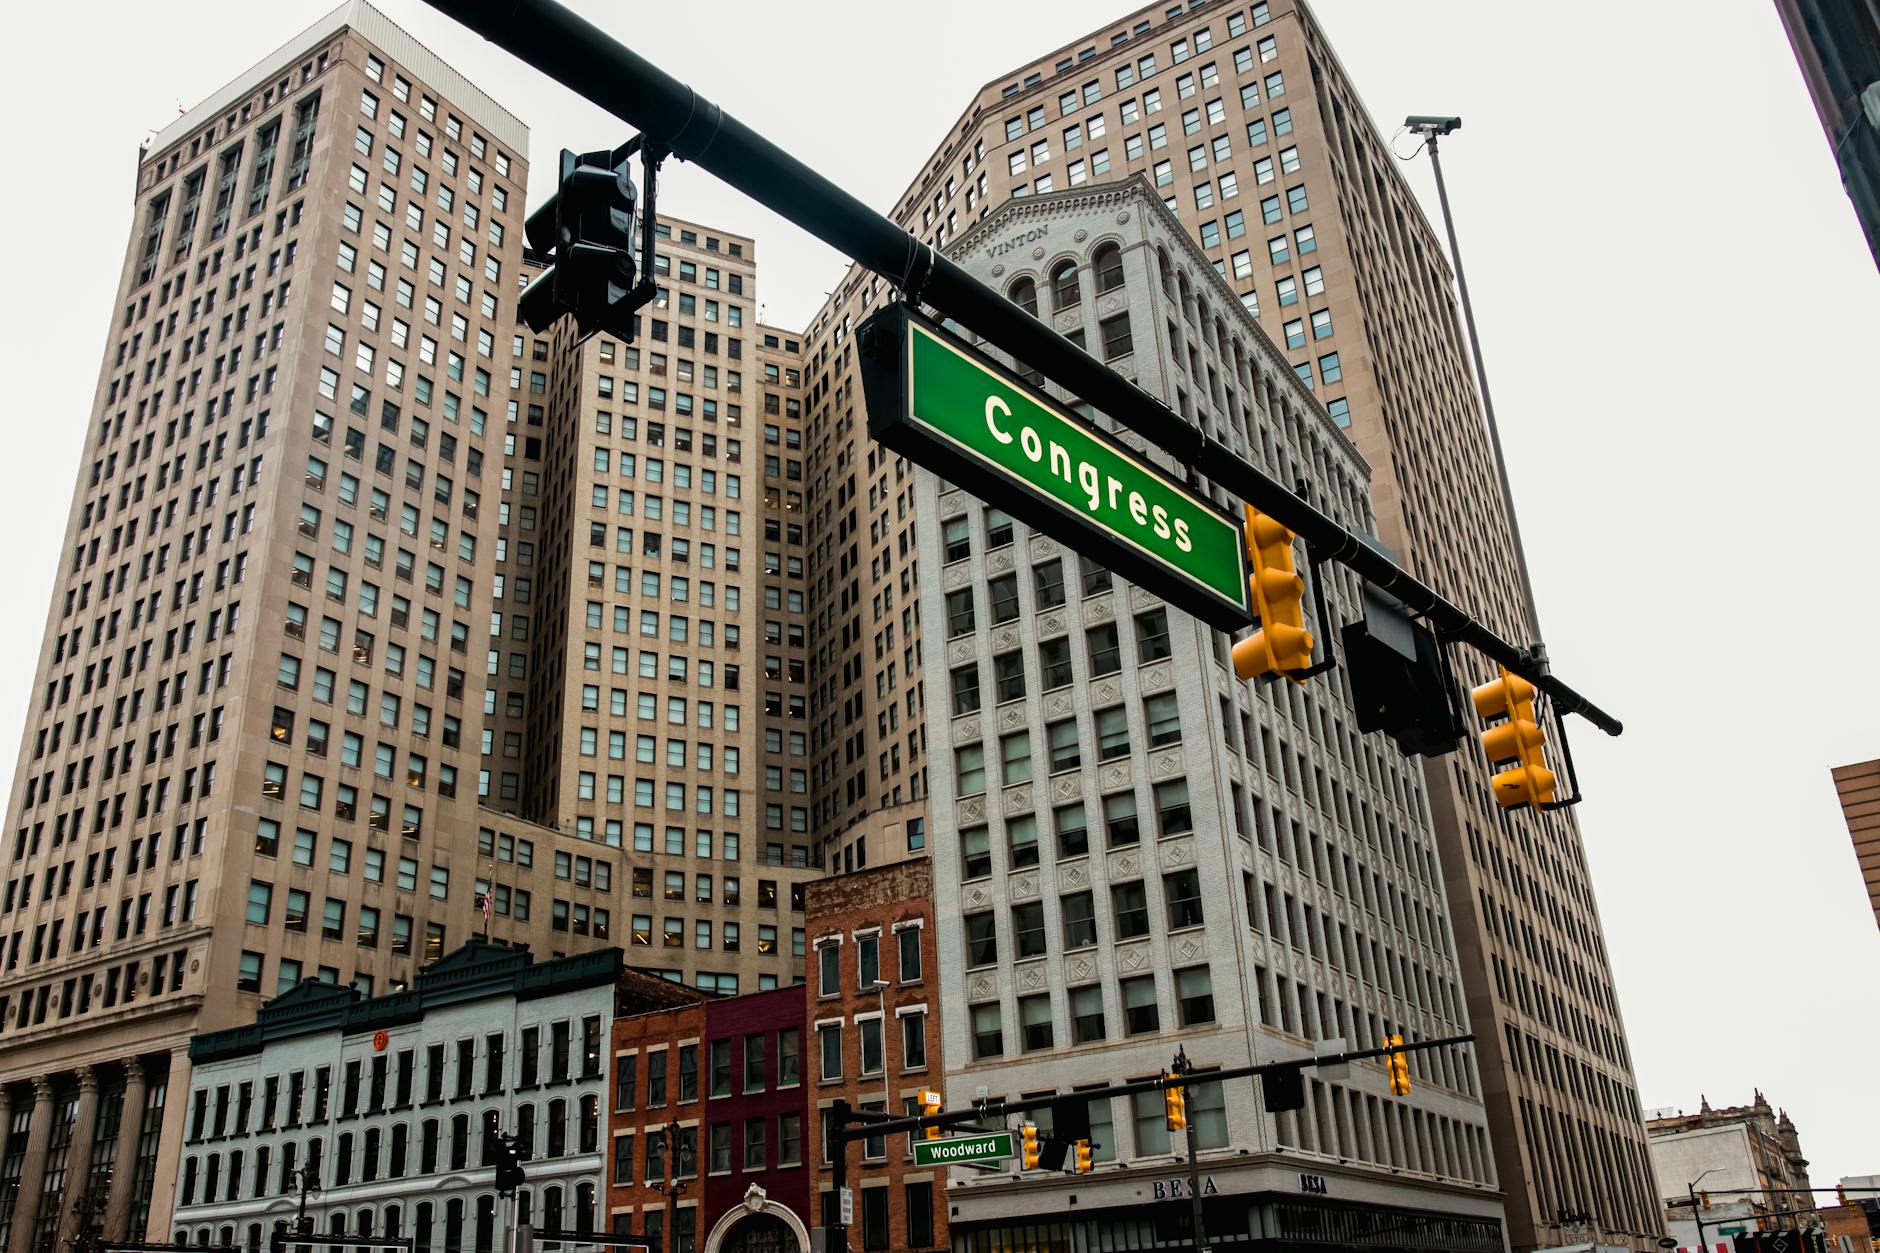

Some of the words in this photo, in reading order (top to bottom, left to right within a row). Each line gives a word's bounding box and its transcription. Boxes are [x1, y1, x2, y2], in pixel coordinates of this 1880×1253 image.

[986, 224, 1048, 258] VINTON
[984, 395, 1193, 553] Congress
[927, 1094, 938, 1103] LEFT
[930, 1139, 996, 1159] Woodward
[1300, 1174, 1327, 1194] BESA
